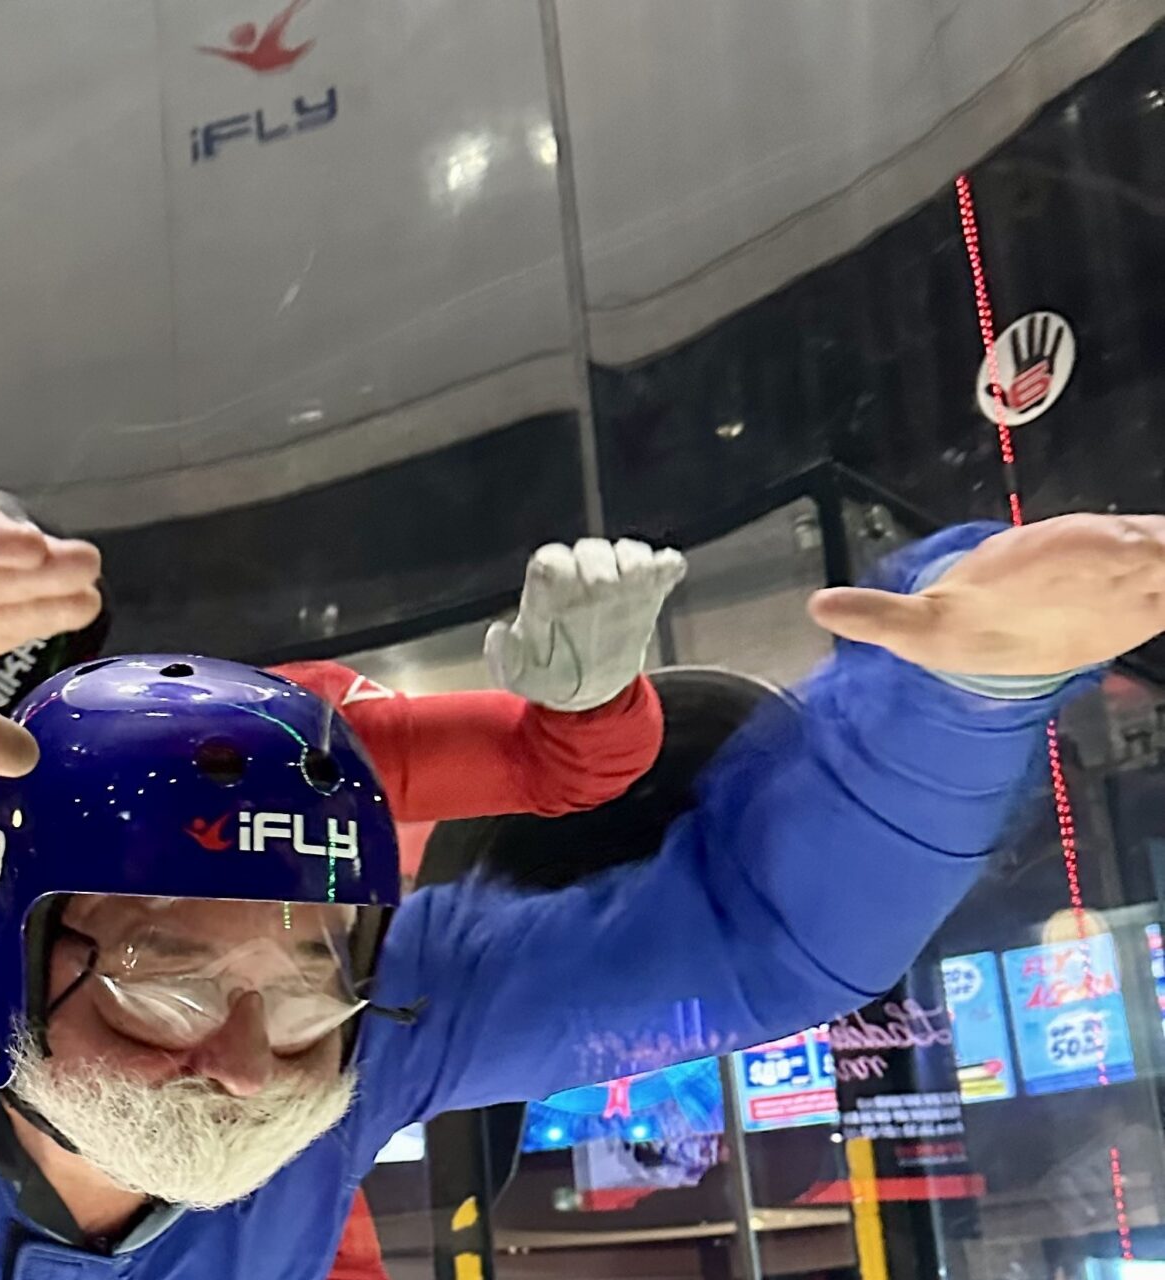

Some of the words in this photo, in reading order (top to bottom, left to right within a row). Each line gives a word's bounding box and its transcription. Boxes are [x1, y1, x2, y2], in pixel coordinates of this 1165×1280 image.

[191, 85, 337, 163] iFLY
[1007, 360, 1053, 409] 6
[238, 811, 358, 860] iFLY
